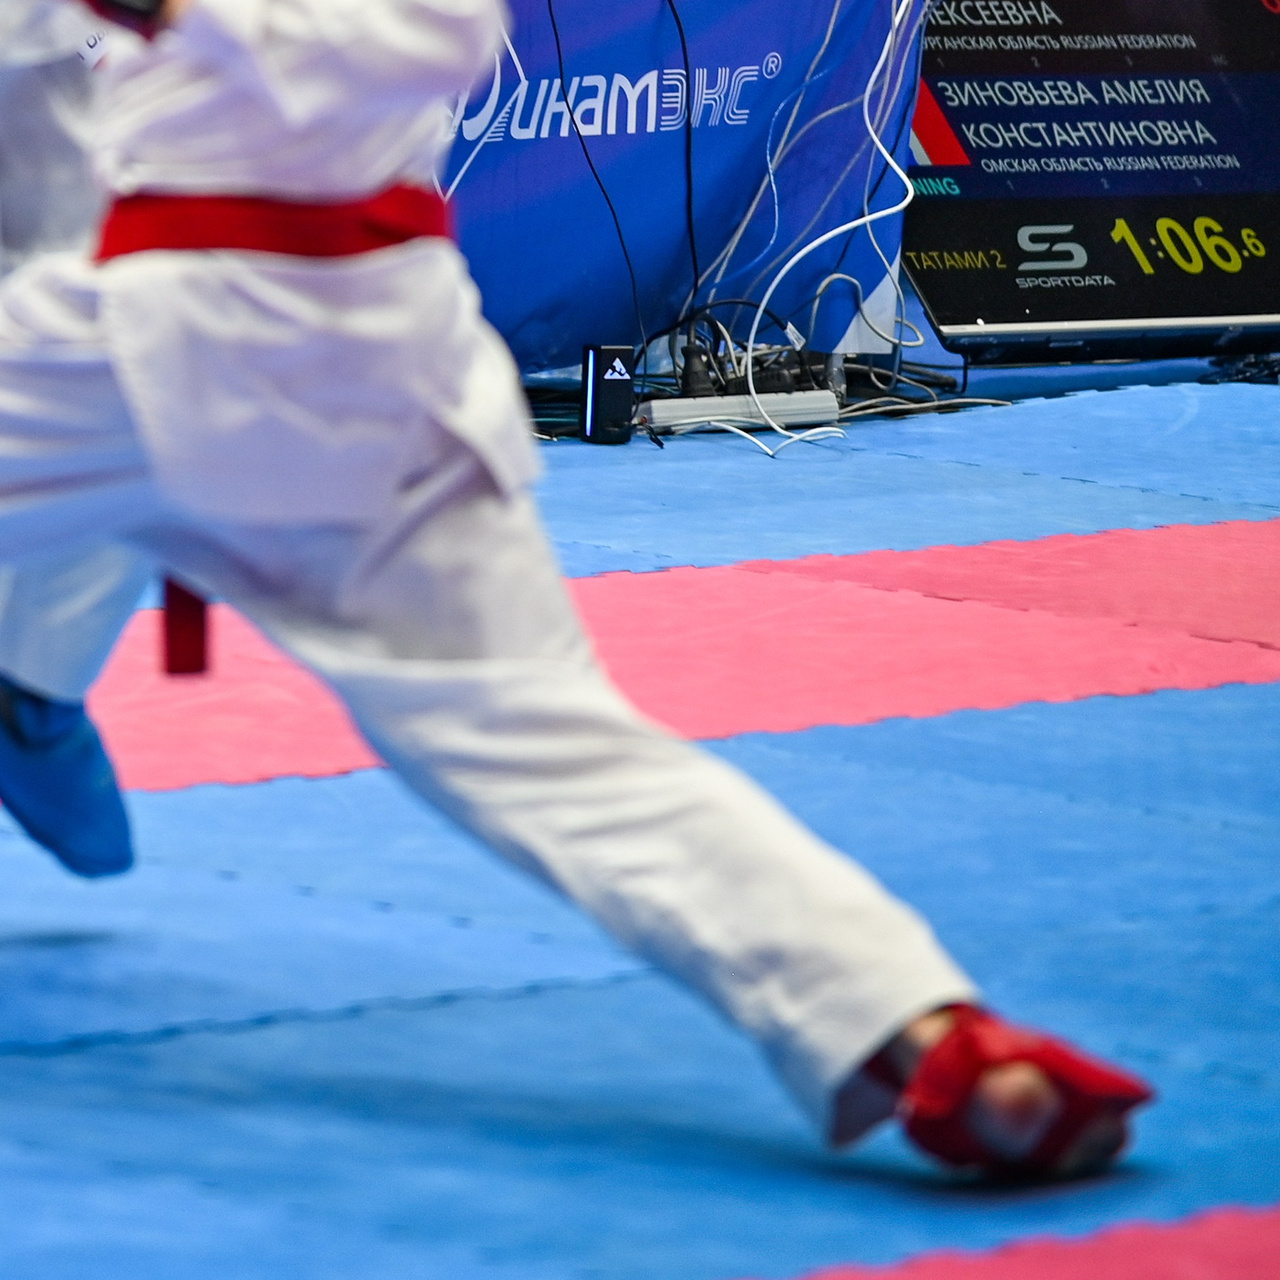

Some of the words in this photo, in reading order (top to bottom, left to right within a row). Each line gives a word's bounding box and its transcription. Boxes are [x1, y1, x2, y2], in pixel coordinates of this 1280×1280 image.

[997, 34, 1061, 50] ОБЛАСТЬ
[1059, 34, 1119, 50] RUSSIAN
[1117, 34, 1198, 49] FEDERATION
[937, 80, 1099, 107] ЗИНОВЬЕВА
[1101, 79, 1211, 105] АМЕЛИЯ
[961, 120, 1218, 149] КОНСТАНТИНОВНА
[981, 158, 1041, 173] ОМСКАЯ
[1040, 157, 1104, 172] ОБЛАСТЬ
[1102, 156, 1161, 171] RUSSIAN
[1160, 154, 1241, 169] FEDERATION
[906, 251, 990, 270] ТАТАМИ
[989, 250, 1007, 268] 2
[1015, 275, 1116, 289] SPORTDATA
